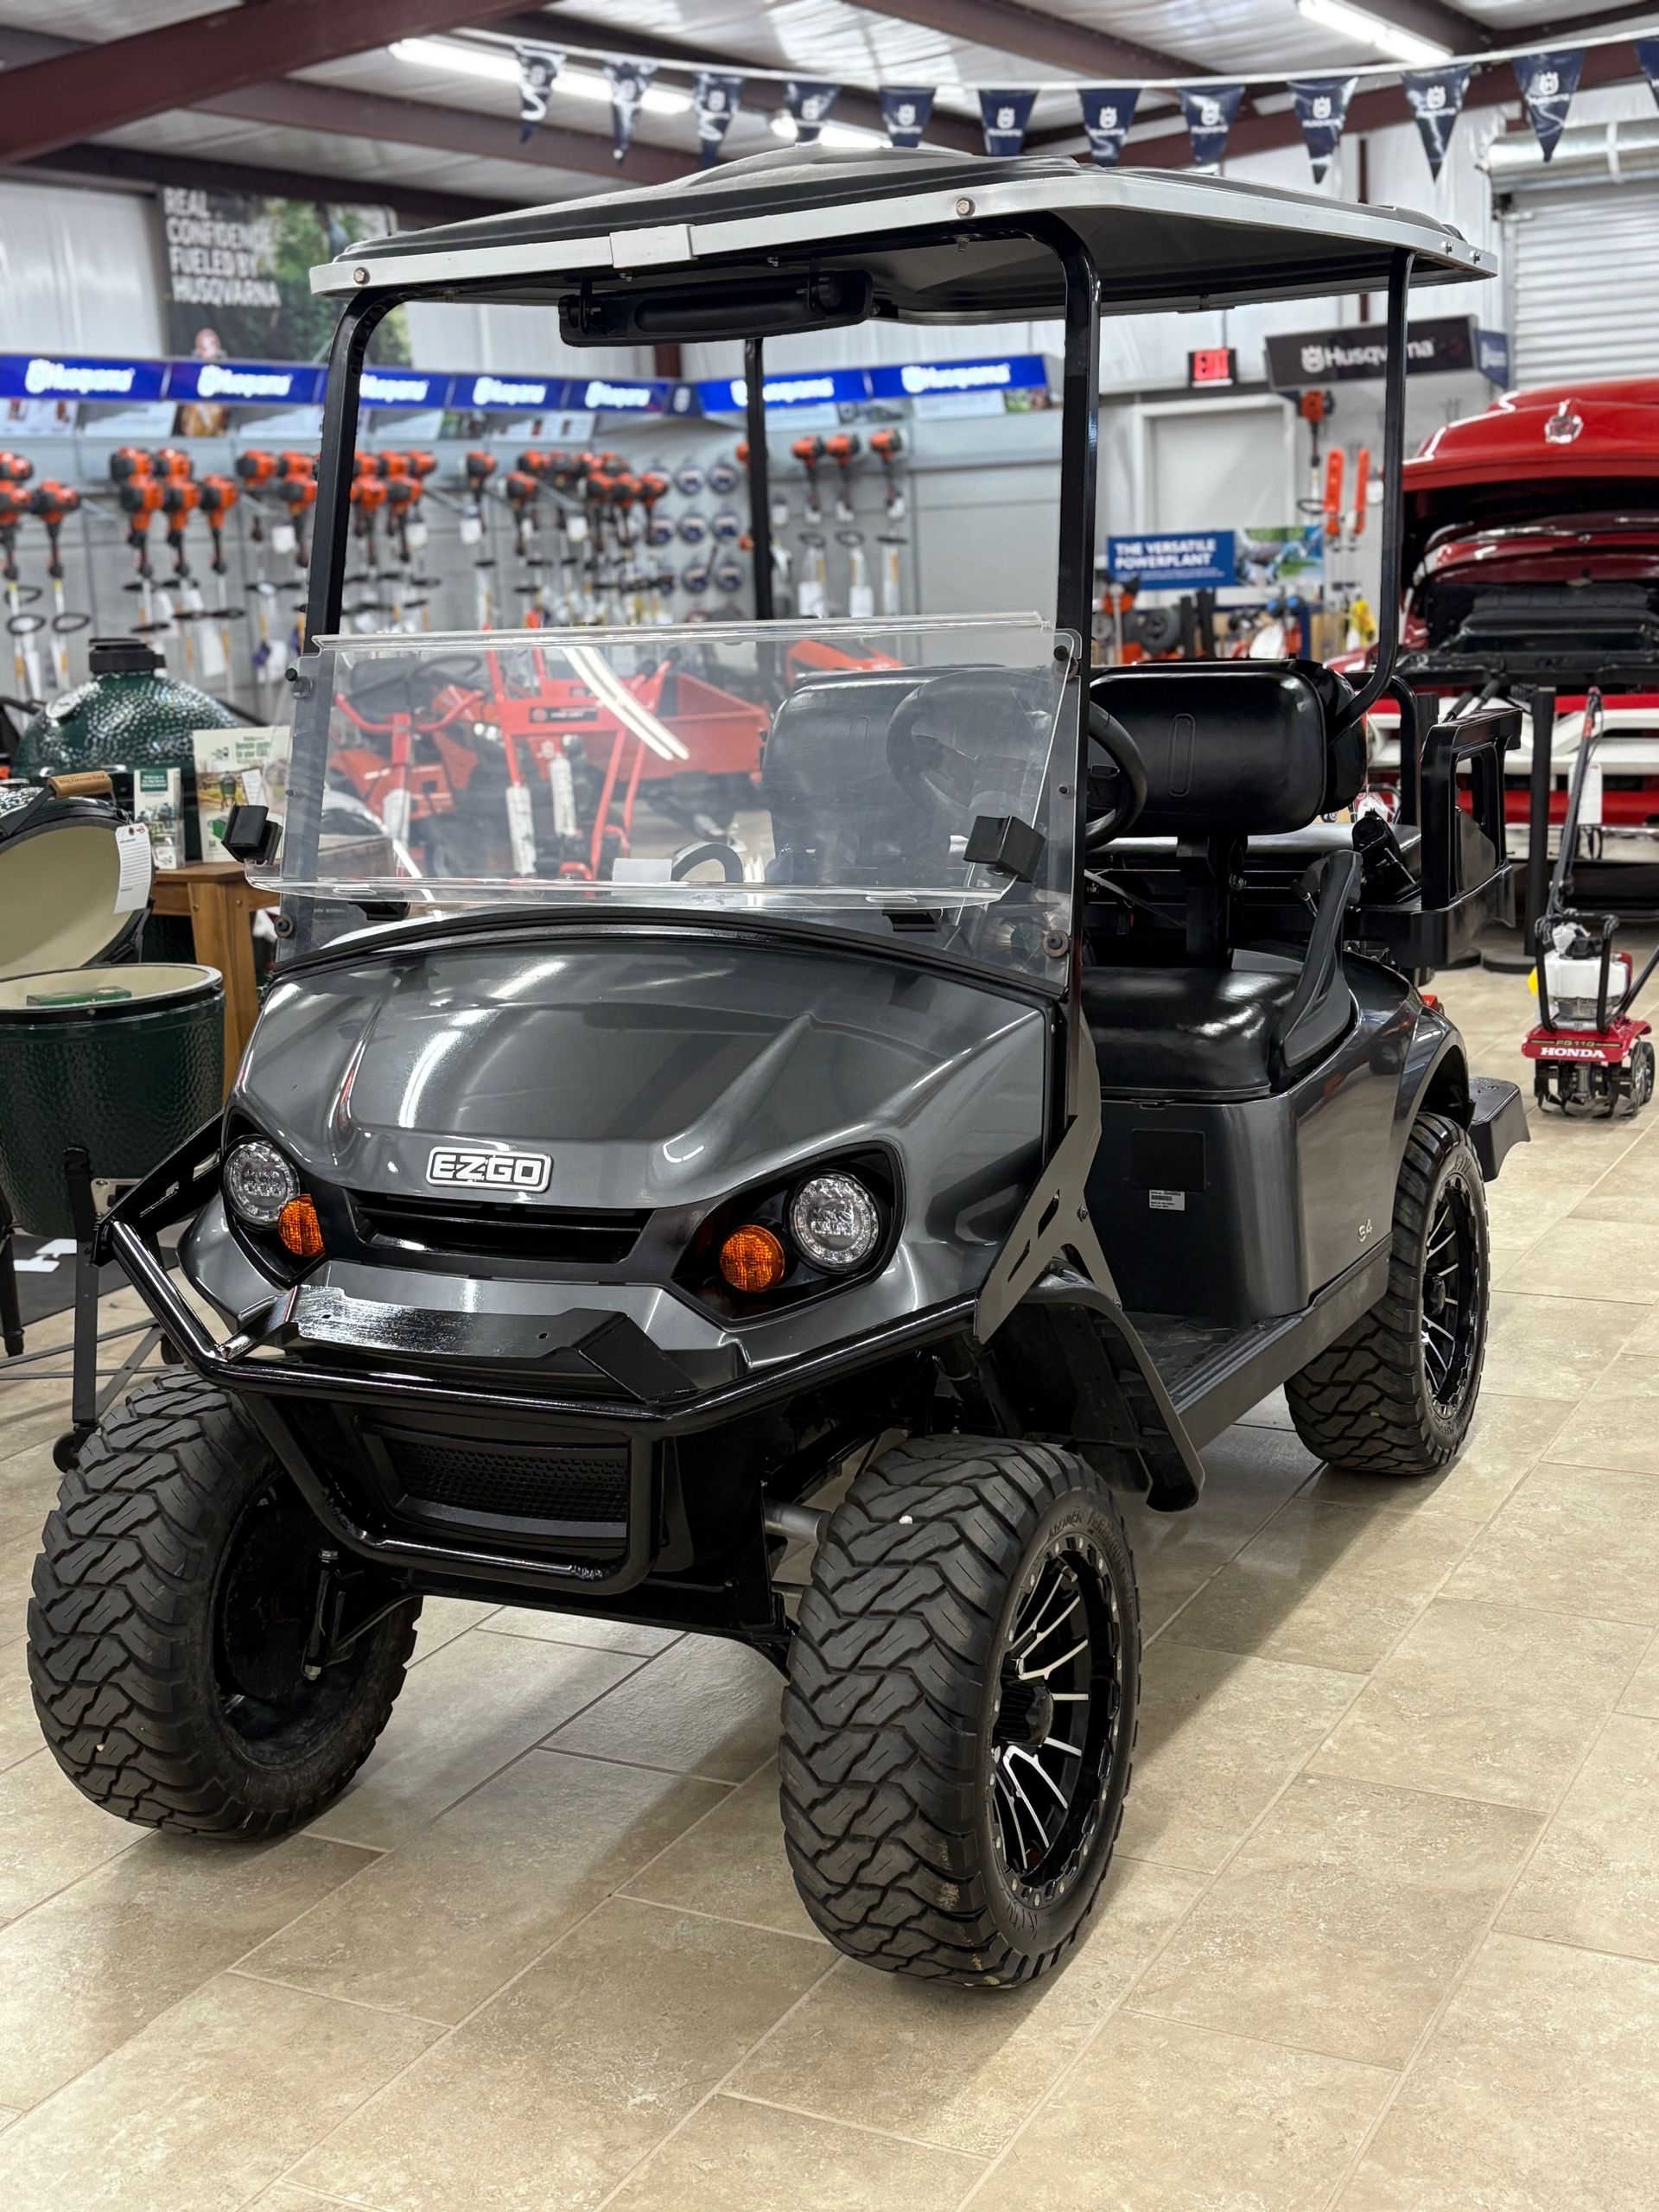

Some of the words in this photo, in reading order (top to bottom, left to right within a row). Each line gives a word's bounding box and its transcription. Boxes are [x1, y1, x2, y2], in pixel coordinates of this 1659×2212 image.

[163, 188, 210, 219] REAL
[168, 246, 235, 276] FUELED
[171, 276, 283, 307] HUSQVARNA
[1194, 349, 1230, 380] EXIT
[1325, 340, 1434, 367] Husqvna
[1114, 542, 1143, 556] THE
[1146, 538, 1217, 555] VERSATILE
[1114, 552, 1213, 570] POWERPLANT
[1541, 1047, 1606, 1058] HONDA
[432, 1154, 543, 1185] EZGO
[1357, 1218, 1373, 1243] S4
